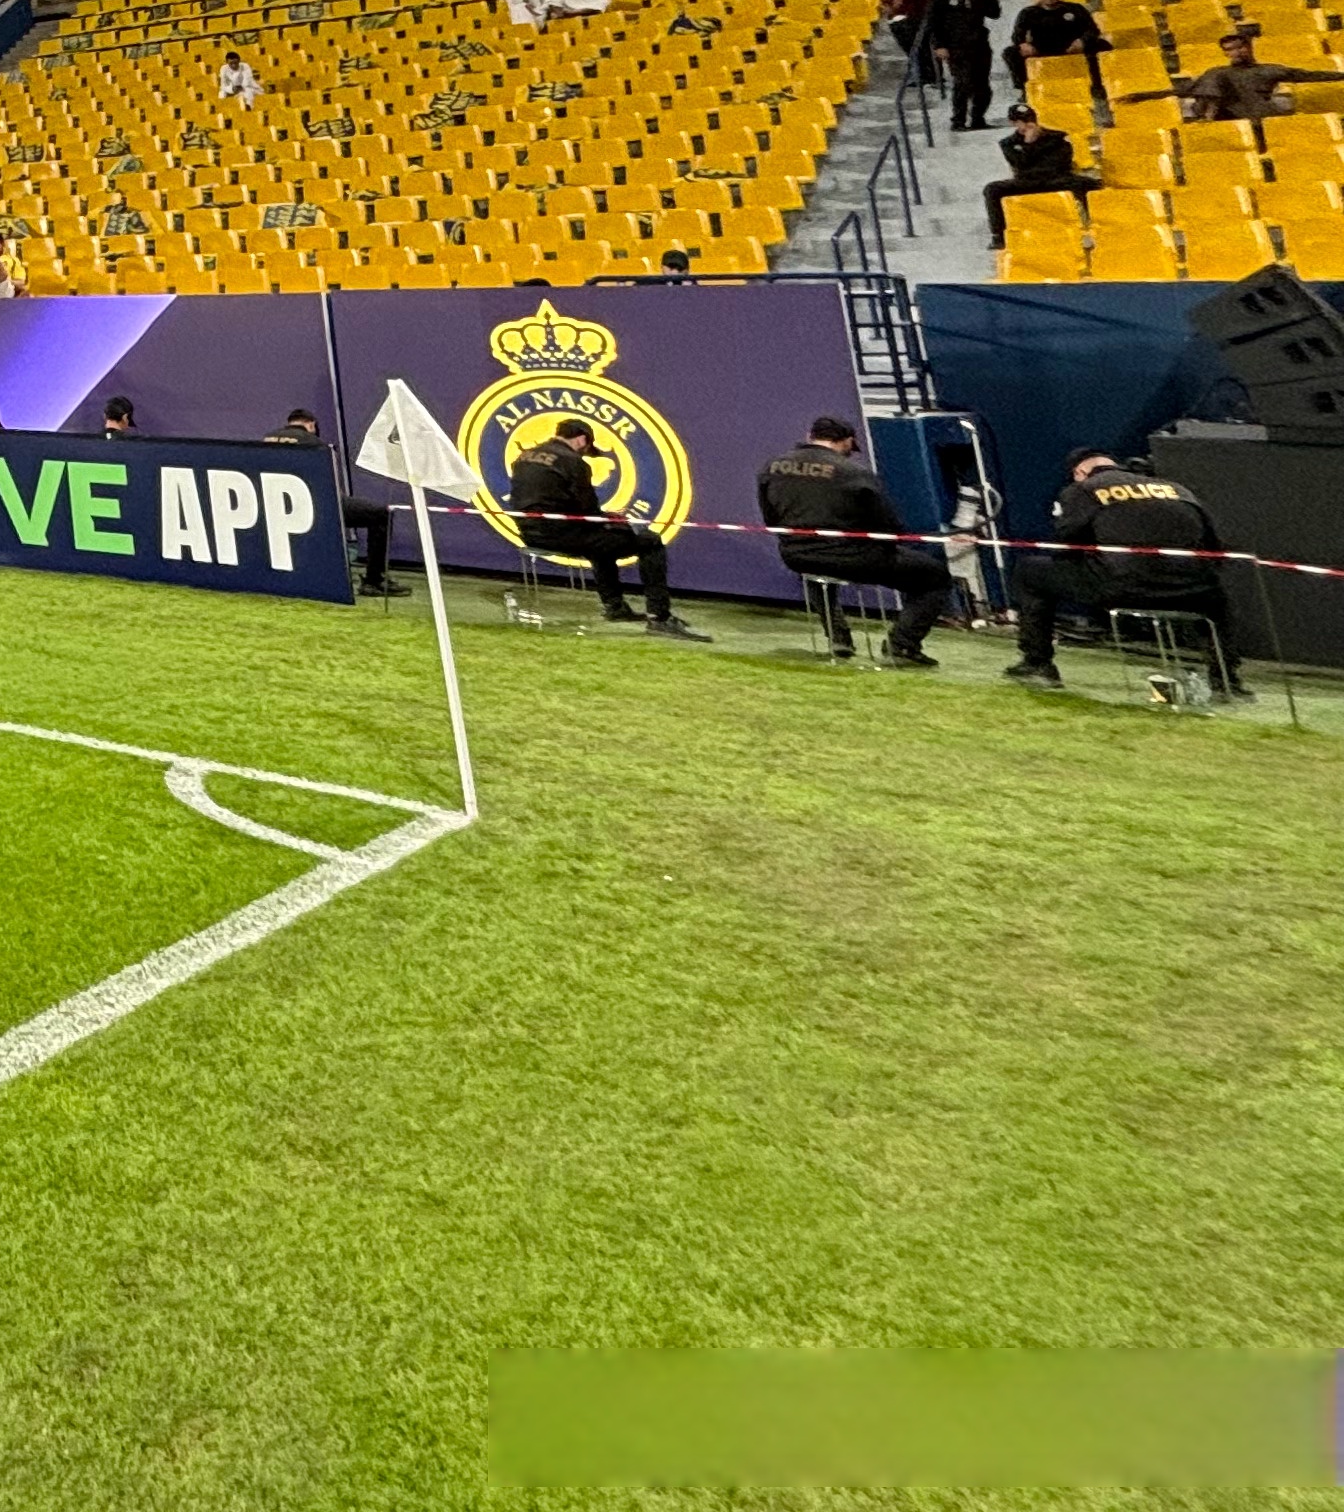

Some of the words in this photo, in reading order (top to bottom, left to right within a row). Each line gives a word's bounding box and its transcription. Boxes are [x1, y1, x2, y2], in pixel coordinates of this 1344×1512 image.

[495, 402, 531, 434] AL
[530, 390, 637, 440] NASSR
[770, 460, 835, 478] POLICE
[1095, 483, 1180, 505] POLICE
[160, 466, 315, 572] APP
